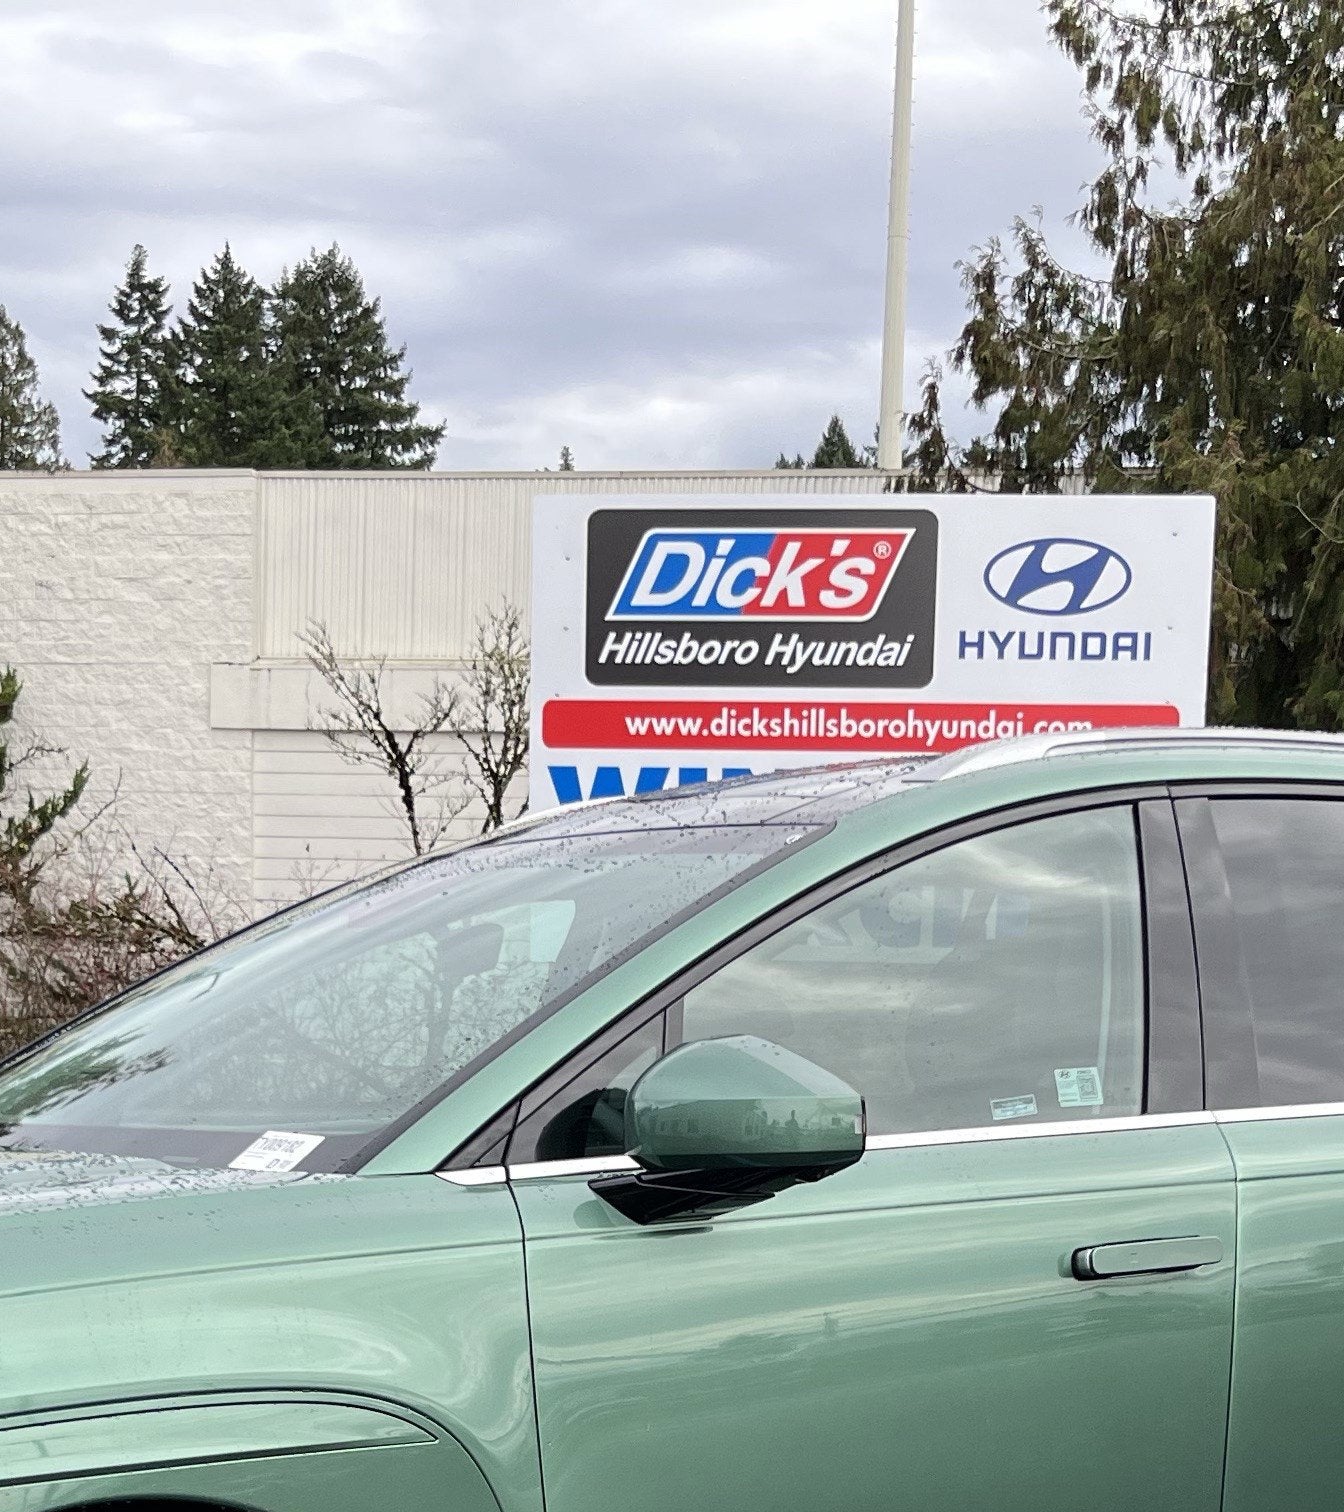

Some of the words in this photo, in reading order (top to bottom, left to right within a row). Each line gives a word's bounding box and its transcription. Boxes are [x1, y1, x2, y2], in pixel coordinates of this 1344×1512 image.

[598, 631, 759, 665] Hillsboro
[764, 633, 914, 674] Hyundai
[959, 630, 1151, 661] HYUNDAI
